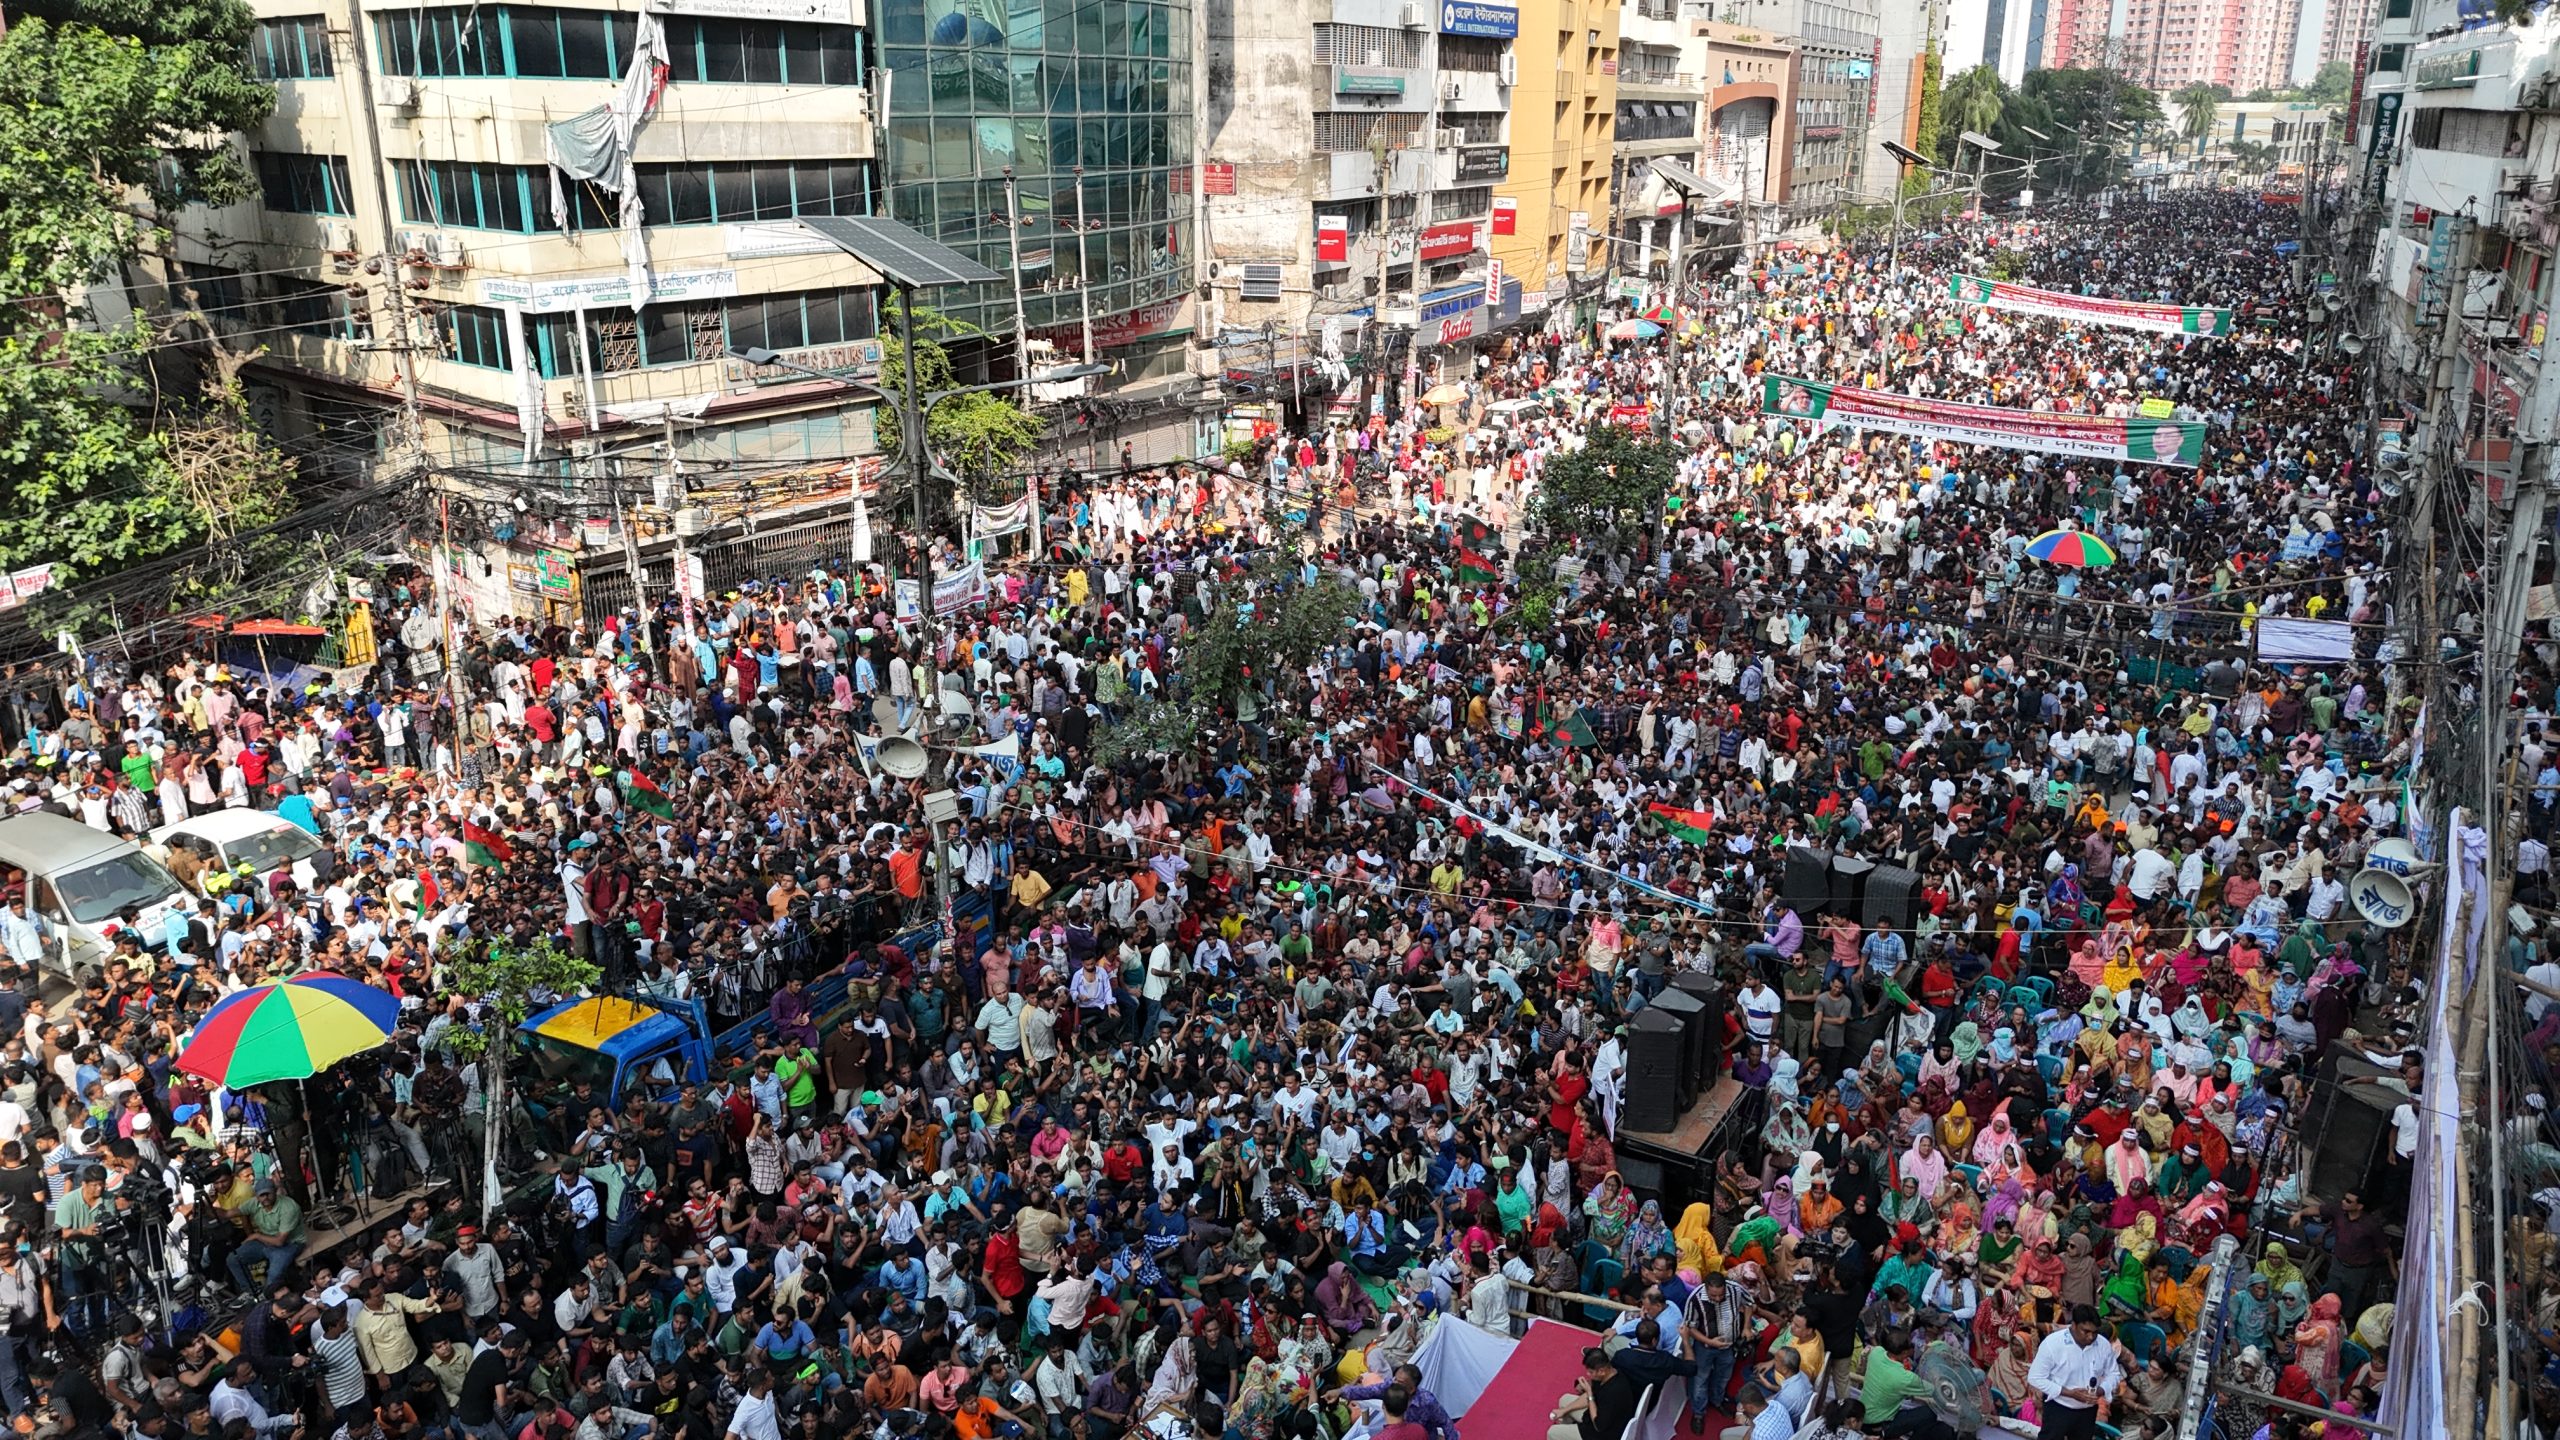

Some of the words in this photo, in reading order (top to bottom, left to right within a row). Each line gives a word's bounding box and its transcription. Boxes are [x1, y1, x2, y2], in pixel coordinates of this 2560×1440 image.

[1455, 22, 1467, 32] WELL
[1467, 23, 1500, 35] INTERNATIONAL
[1487, 262, 1499, 303] Bata
[1439, 317, 1474, 343] Bata
[830, 345, 864, 368] TOURS
